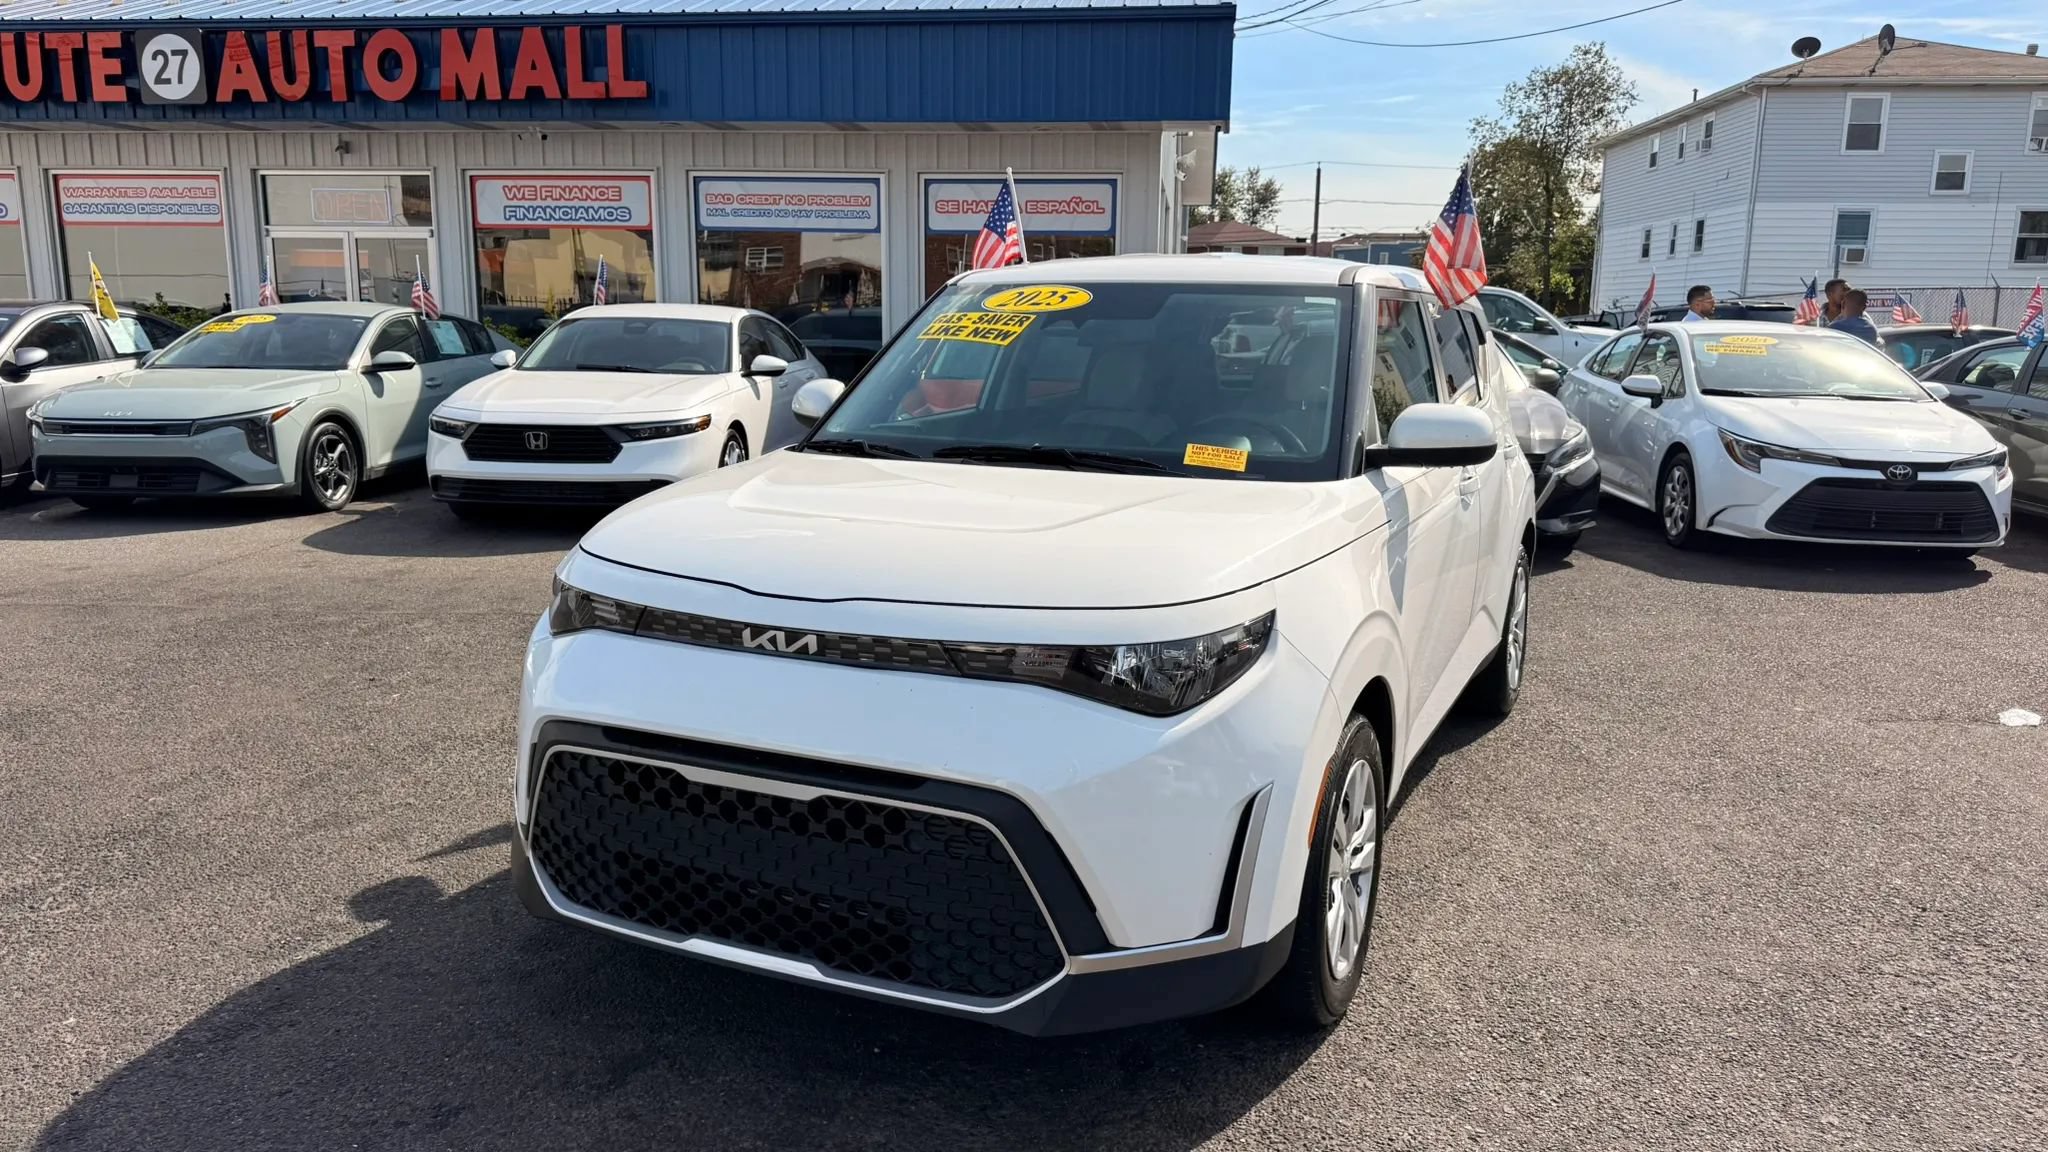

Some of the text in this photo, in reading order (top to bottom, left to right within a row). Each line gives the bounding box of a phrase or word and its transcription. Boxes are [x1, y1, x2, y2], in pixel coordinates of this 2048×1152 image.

[151, 49, 189, 86] 27
[216, 28, 418, 102] AUTO
[439, 24, 648, 100] MALL
[63, 187, 216, 199] WARRANTIES AVAILABLE
[503, 185, 623, 201] WE FINANCE
[705, 193, 871, 207] BAD CREDIT NO PROBLEM
[63, 203, 220, 215] GARANTIAS DISPONIBLES
[935, 199, 961, 214] SE
[1025, 196, 1105, 214] ESPAÑOL
[504, 205, 632, 222] FINANCIAMOS
[706, 208, 871, 219] MAL CREDITO NO HAY PROBLEMA
[995, 290, 1079, 308] 2025
[971, 314, 1031, 327] SAVER
[922, 325, 1018, 341] LIKE NEW
[1211, 447, 1244, 456] VEHICLE
[742, 627, 818, 655] KIA
